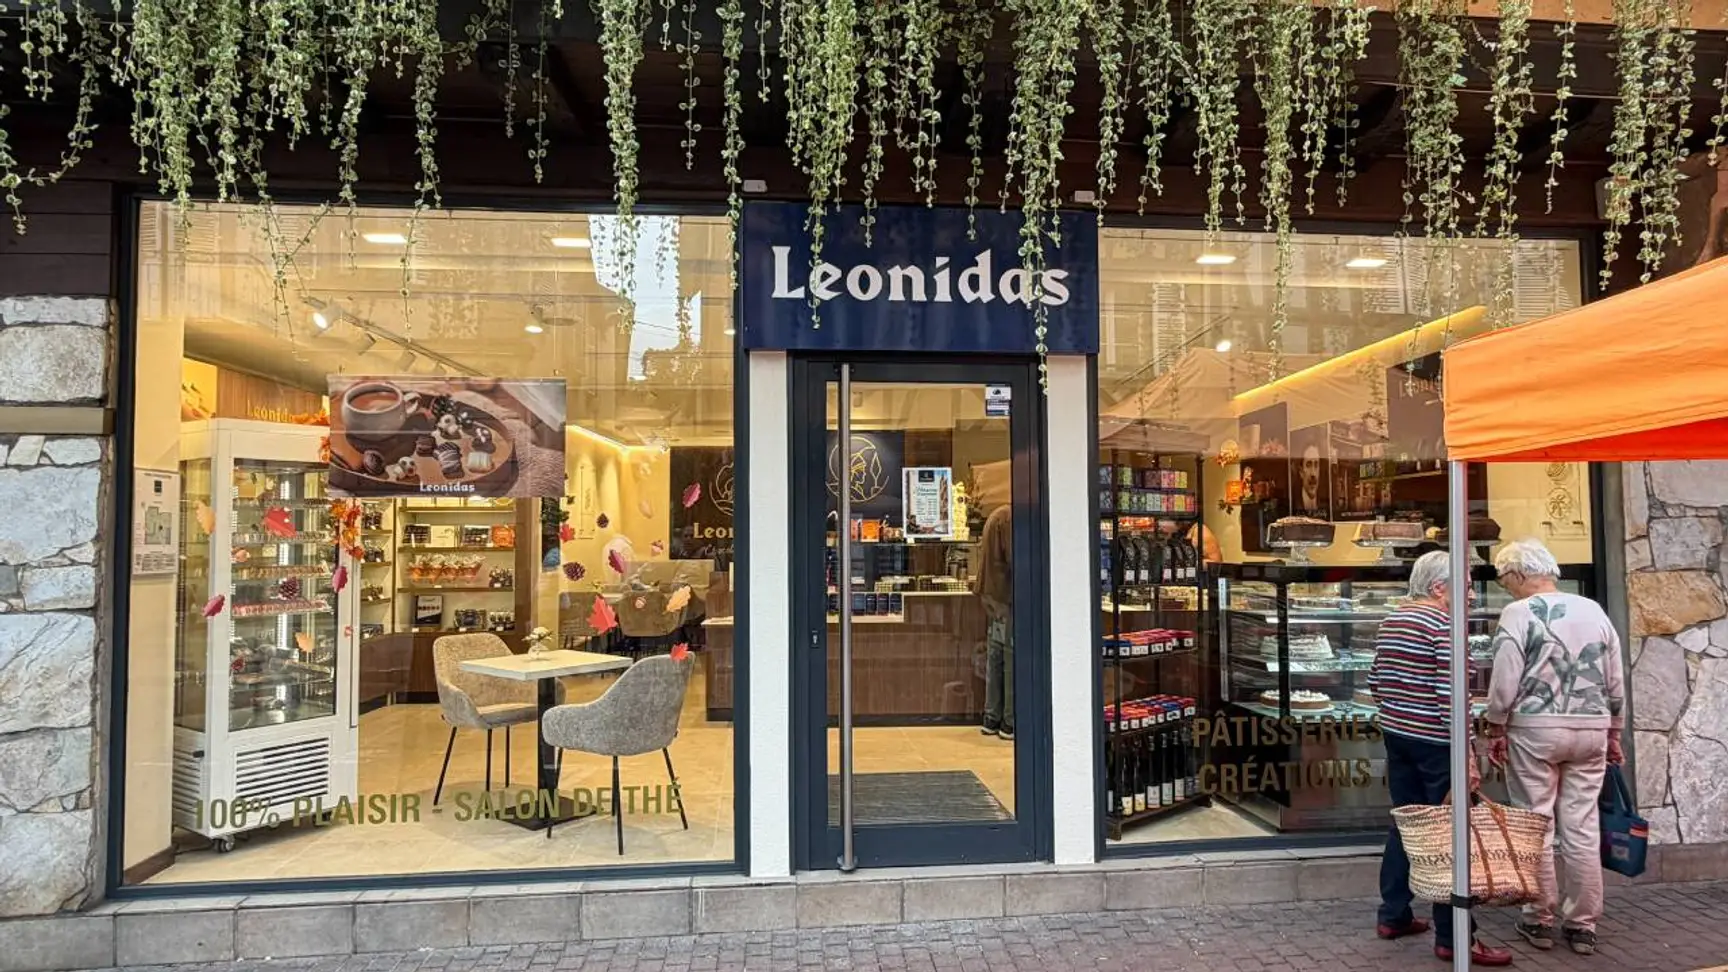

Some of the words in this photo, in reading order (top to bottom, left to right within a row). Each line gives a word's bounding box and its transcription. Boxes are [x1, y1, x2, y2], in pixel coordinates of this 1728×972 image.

[771, 246, 1070, 306] Leonidas
[420, 481, 476, 492] Leonidas
[1192, 710, 1384, 748] PÂTISSERIES
[1200, 755, 1371, 794] CRÉATIONS
[195, 799, 280, 829] 100%
[293, 793, 421, 827] PLAISIR
[454, 788, 560, 822] SALON
[573, 787, 613, 817] DE
